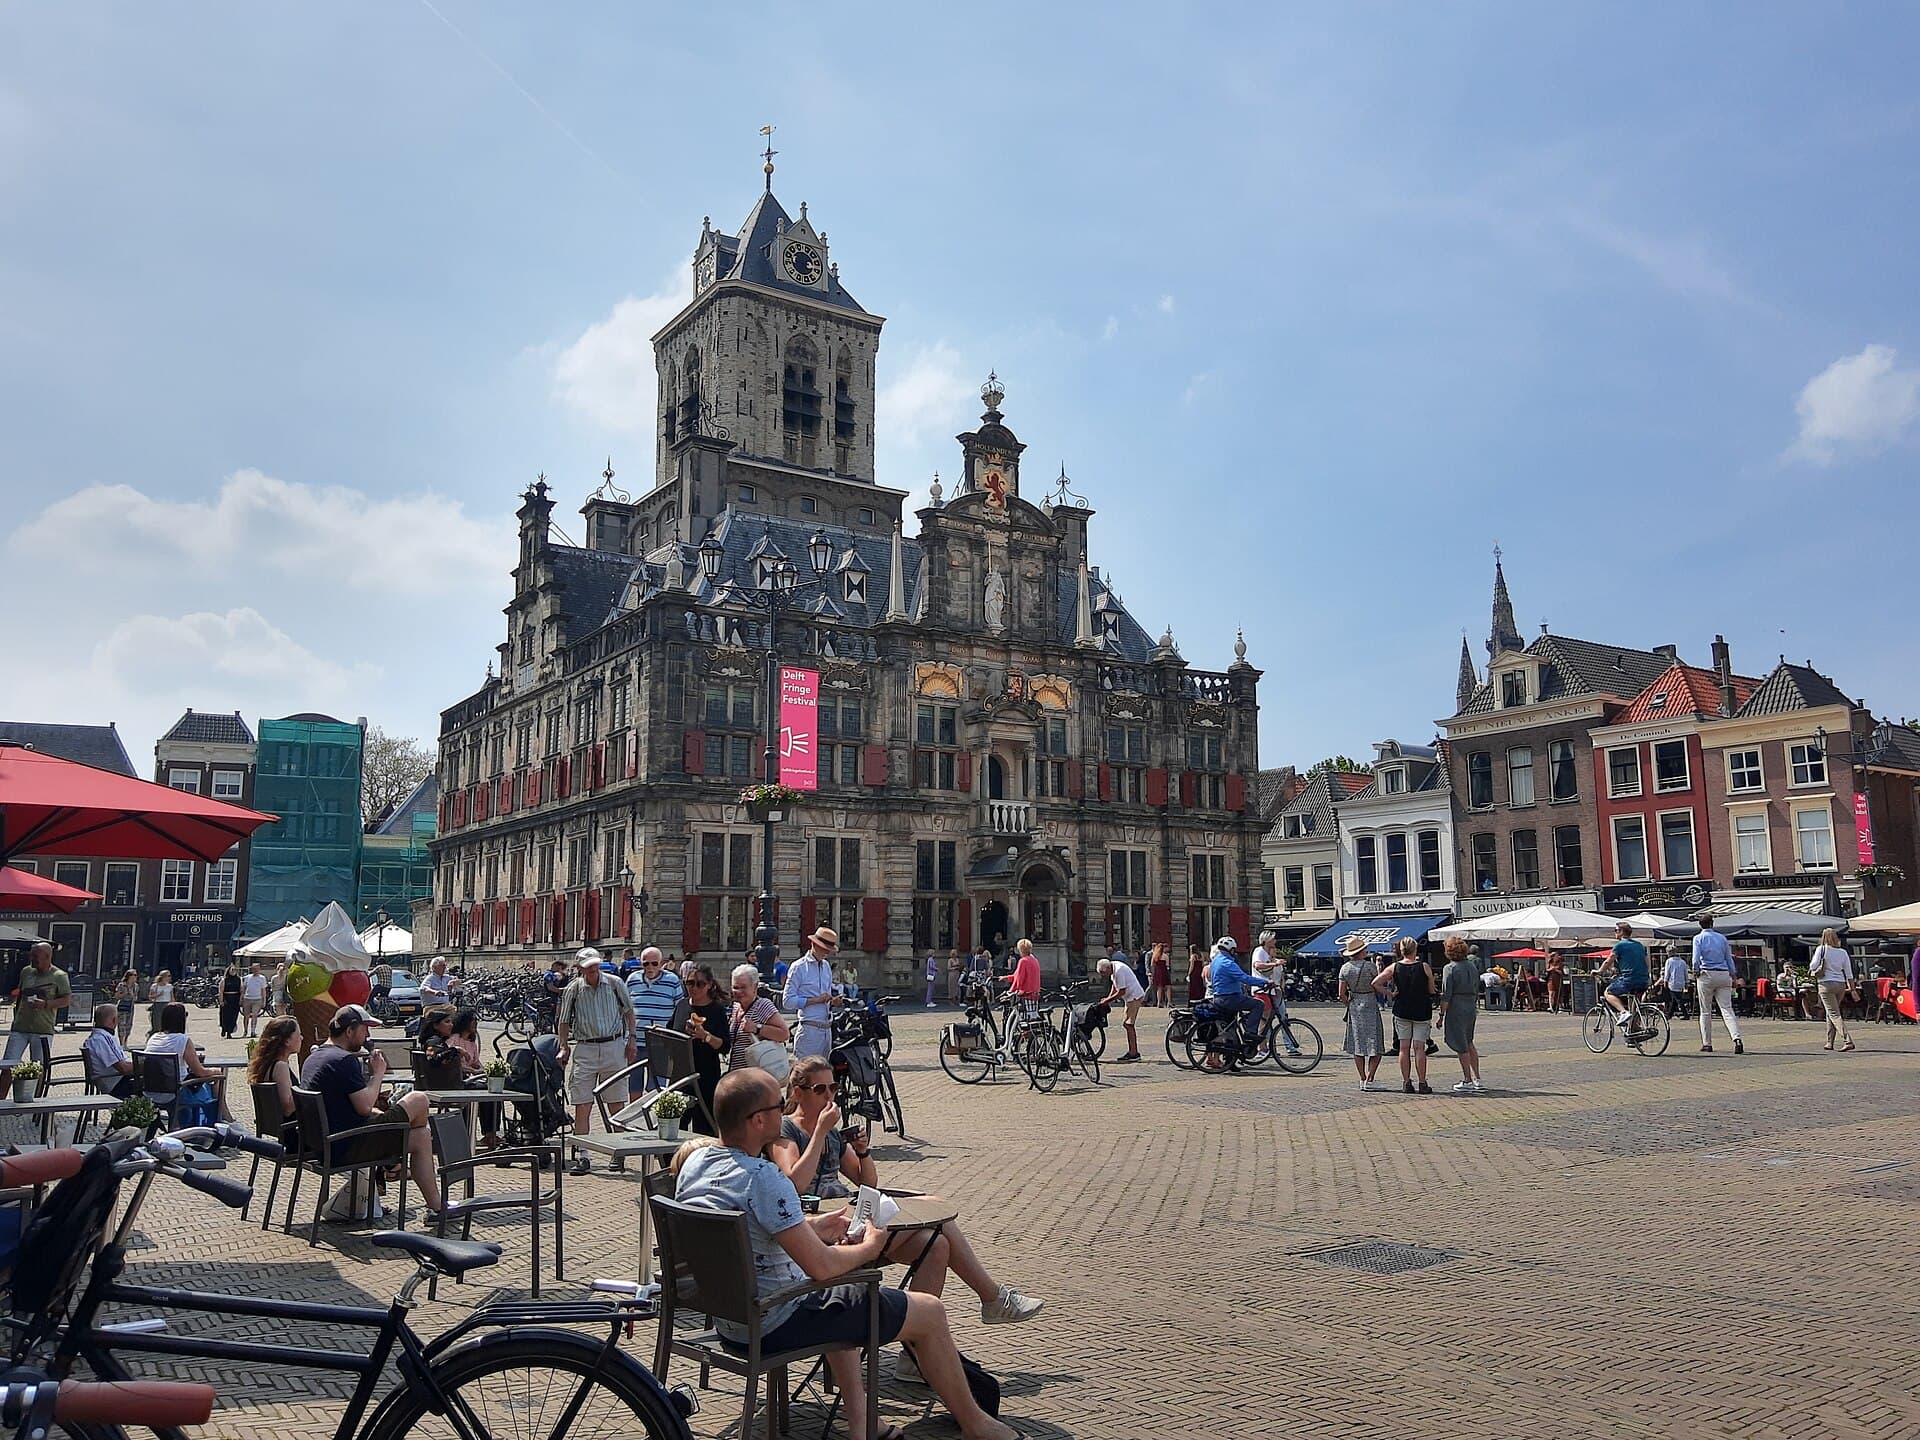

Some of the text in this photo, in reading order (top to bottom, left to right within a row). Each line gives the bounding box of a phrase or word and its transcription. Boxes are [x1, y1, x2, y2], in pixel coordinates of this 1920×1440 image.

[783, 670, 806, 681] Delft
[783, 682, 811, 696] Fringe
[783, 694, 816, 706] Festival
[1453, 705, 1593, 735] HET NIEUWE ANKER
[1757, 876, 1825, 886] LIEFHEBBER
[1472, 901, 1532, 914] SOUVENIRS
[170, 913, 223, 922] BOTERHUIS
